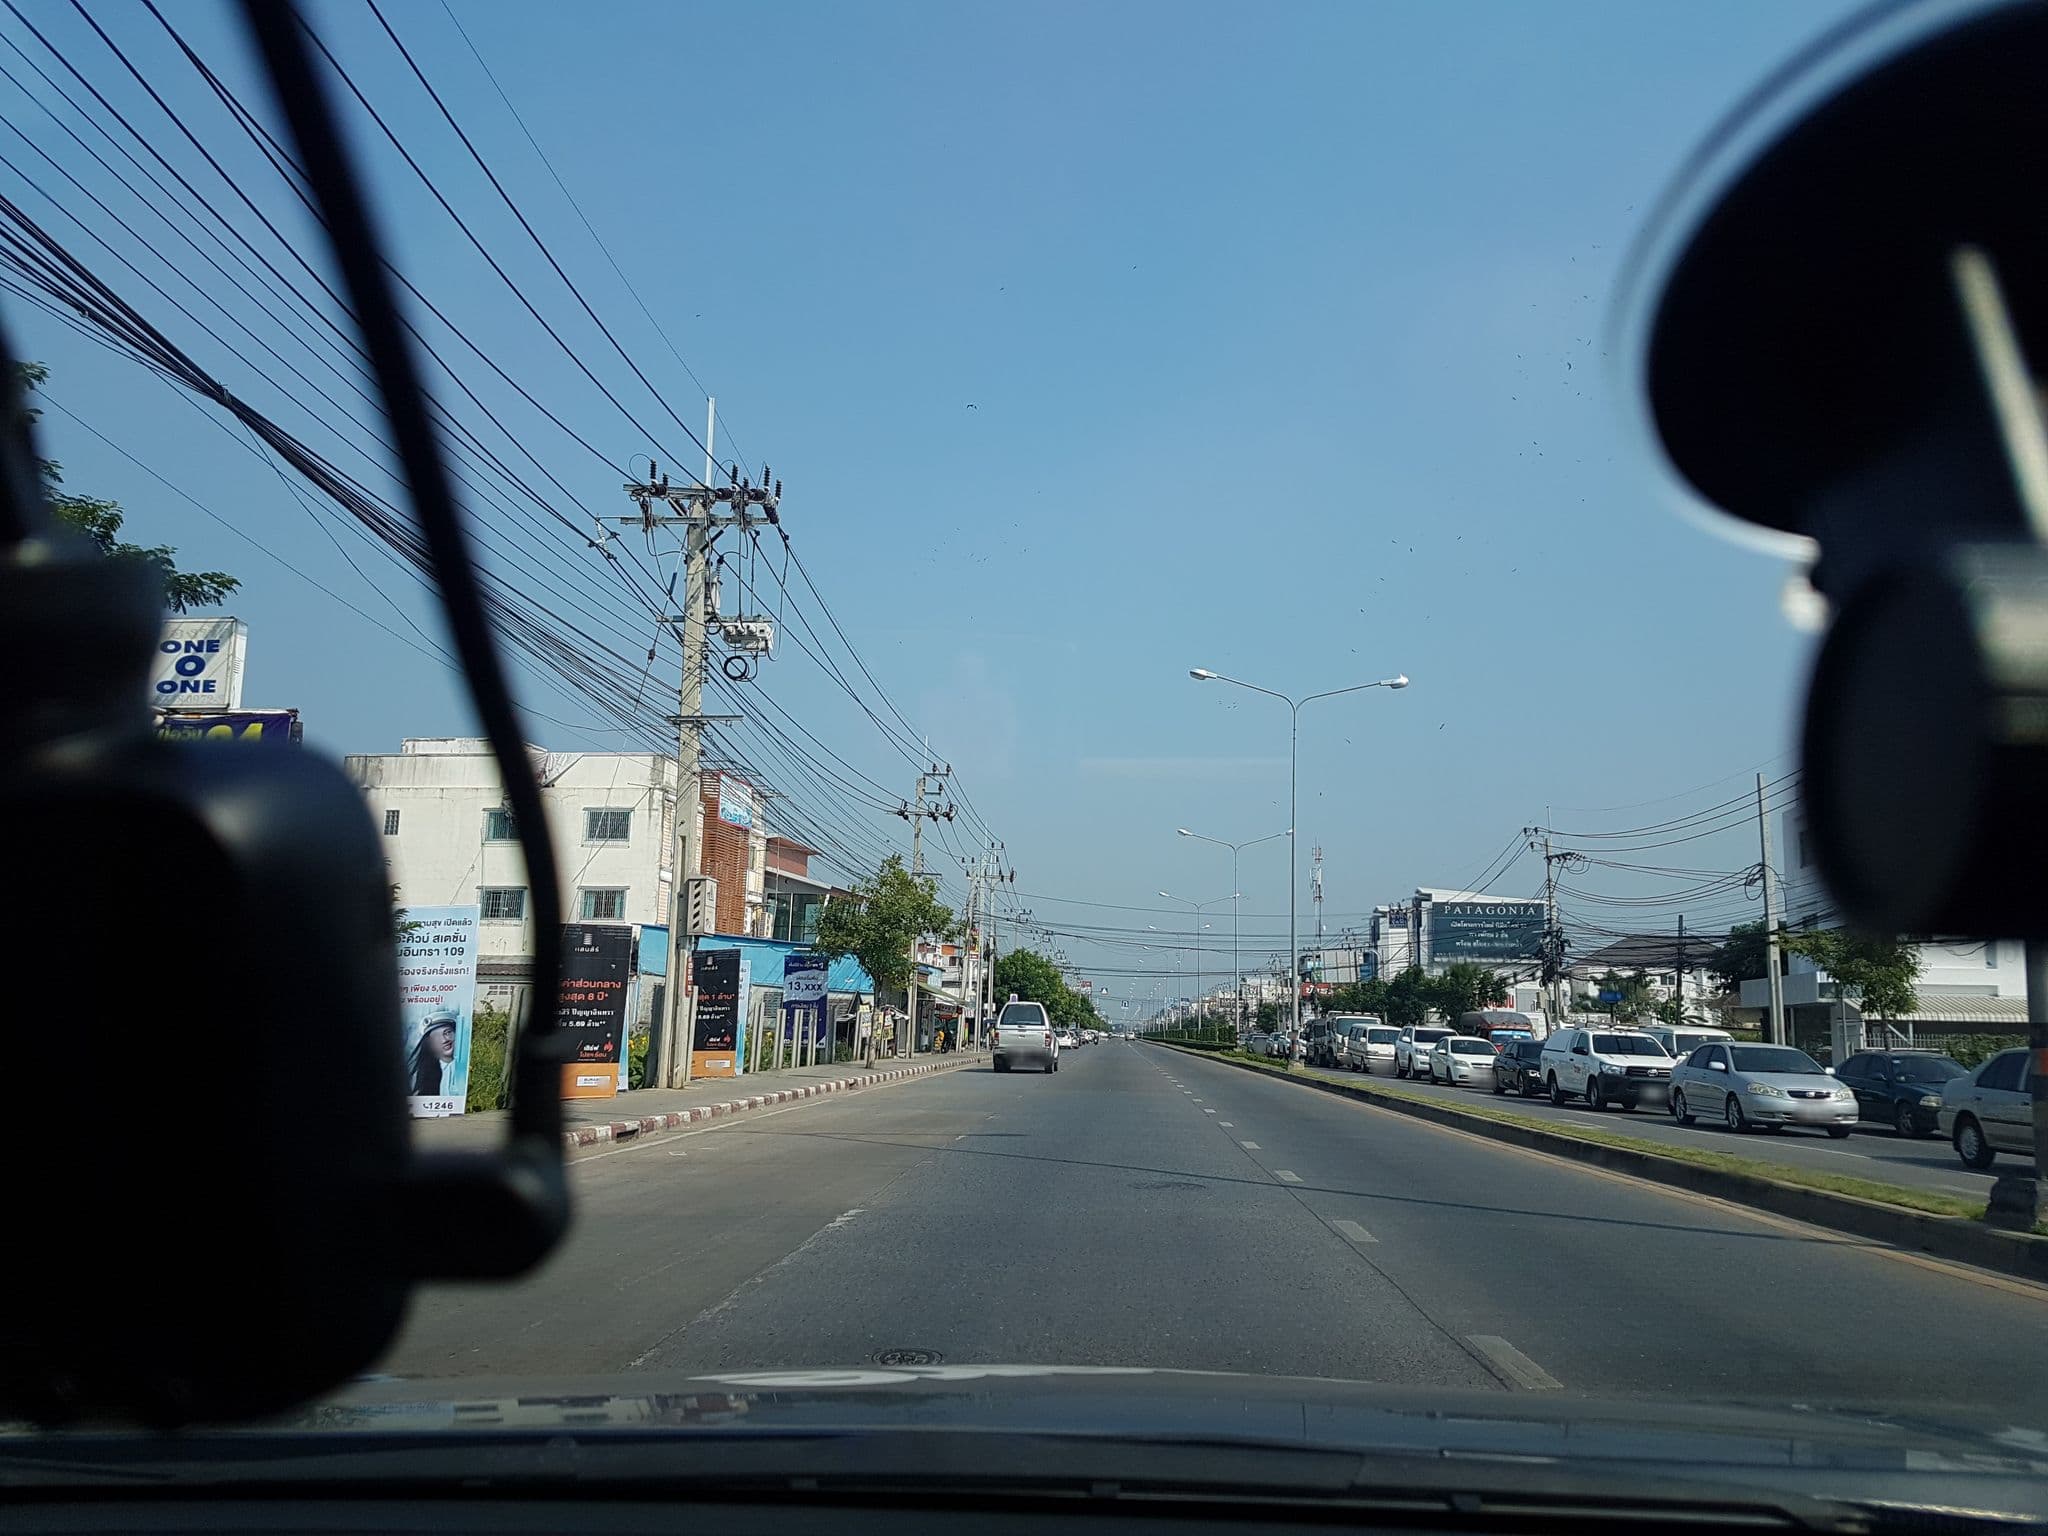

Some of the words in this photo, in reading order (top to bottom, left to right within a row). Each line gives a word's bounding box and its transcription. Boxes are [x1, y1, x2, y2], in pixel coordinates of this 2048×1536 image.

[160, 640, 220, 653] ONE
[175, 655, 206, 677] O
[156, 680, 216, 694] ONE
[1444, 905, 1536, 915] PATAGONIA
[443, 947, 465, 957] 109
[429, 1102, 454, 1110] 1246
